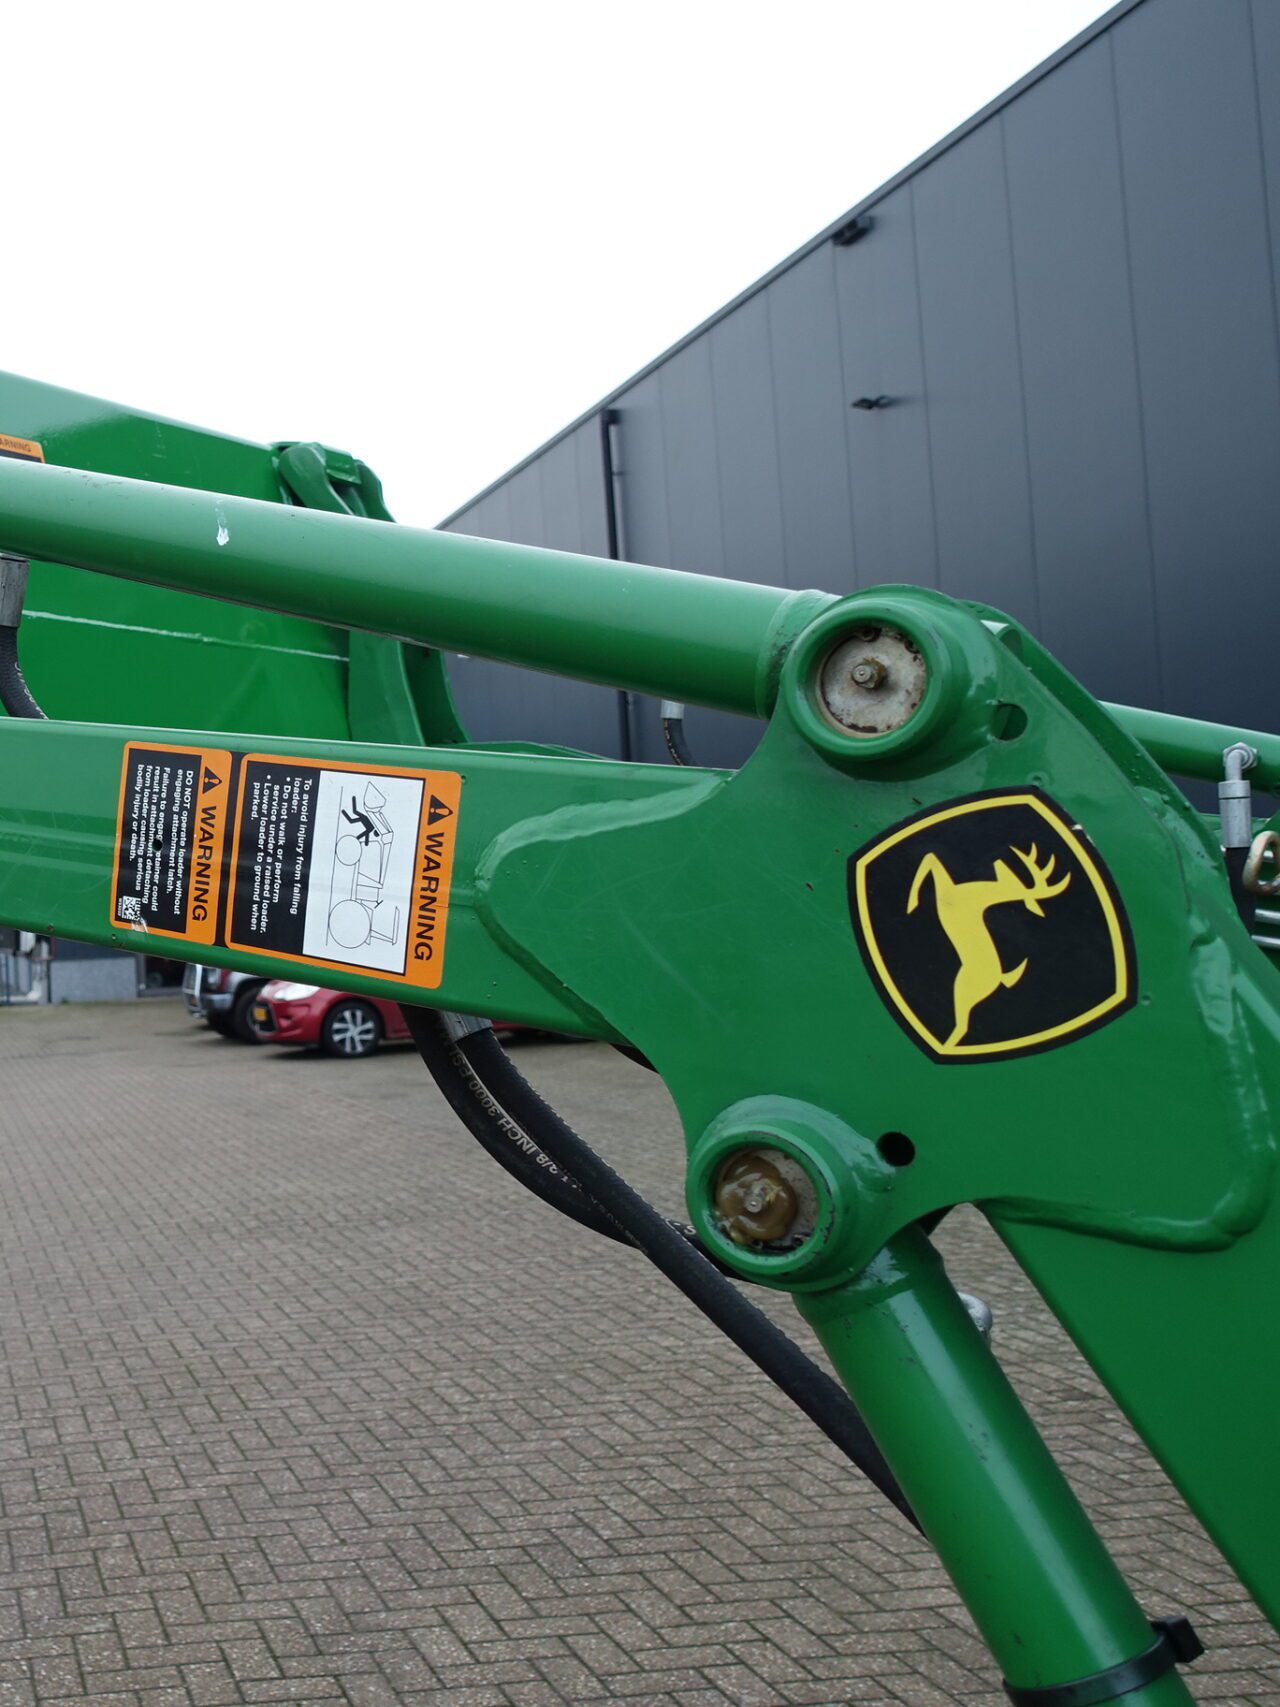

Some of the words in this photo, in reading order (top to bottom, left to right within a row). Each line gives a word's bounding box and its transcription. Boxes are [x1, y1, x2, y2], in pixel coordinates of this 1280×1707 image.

[135, 764, 144, 792] bodily
[145, 765, 153, 786] from
[161, 767, 170, 798] Failure
[173, 769, 183, 812] engaging
[186, 771, 193, 785] DO
[304, 779, 312, 790] To
[132, 794, 141, 819] injury
[142, 789, 151, 818] loader
[152, 794, 159, 802] in
[160, 801, 167, 810] to
[183, 788, 192, 809] NOT
[251, 782, 260, 820] parked.
[262, 783, 271, 814] Lower
[271, 785, 280, 821] service
[283, 785, 291, 799] Do
[291, 778, 302, 813] loader:
[300, 794, 310, 821] avoid
[132, 821, 138, 831] or
[280, 802, 288, 819] not
[138, 820, 147, 855] causing
[156, 812, 164, 843] engag
[169, 814, 179, 867] attachment
[180, 811, 188, 846] operate
[258, 817, 268, 849] loader
[267, 824, 275, 854] under
[296, 825, 307, 853] injury
[153, 849, 162, 883] etainer
[177, 849, 186, 878] loader
[192, 806, 216, 921] WARNING
[257, 852, 264, 862] to
[277, 849, 283, 860] or
[294, 856, 304, 880] from
[142, 859, 151, 903] detaching
[167, 869, 175, 894] latch.
[253, 865, 261, 901] ground
[263, 866, 272, 897] raised
[272, 862, 281, 903] perform
[414, 832, 444, 961] WARNING
[174, 880, 182, 915] without
[290, 883, 301, 914] falling
[251, 904, 259, 930] when
[260, 900, 270, 933] loader.
[469, 1080, 500, 1117] 3000
[497, 1117, 538, 1155] INCH
